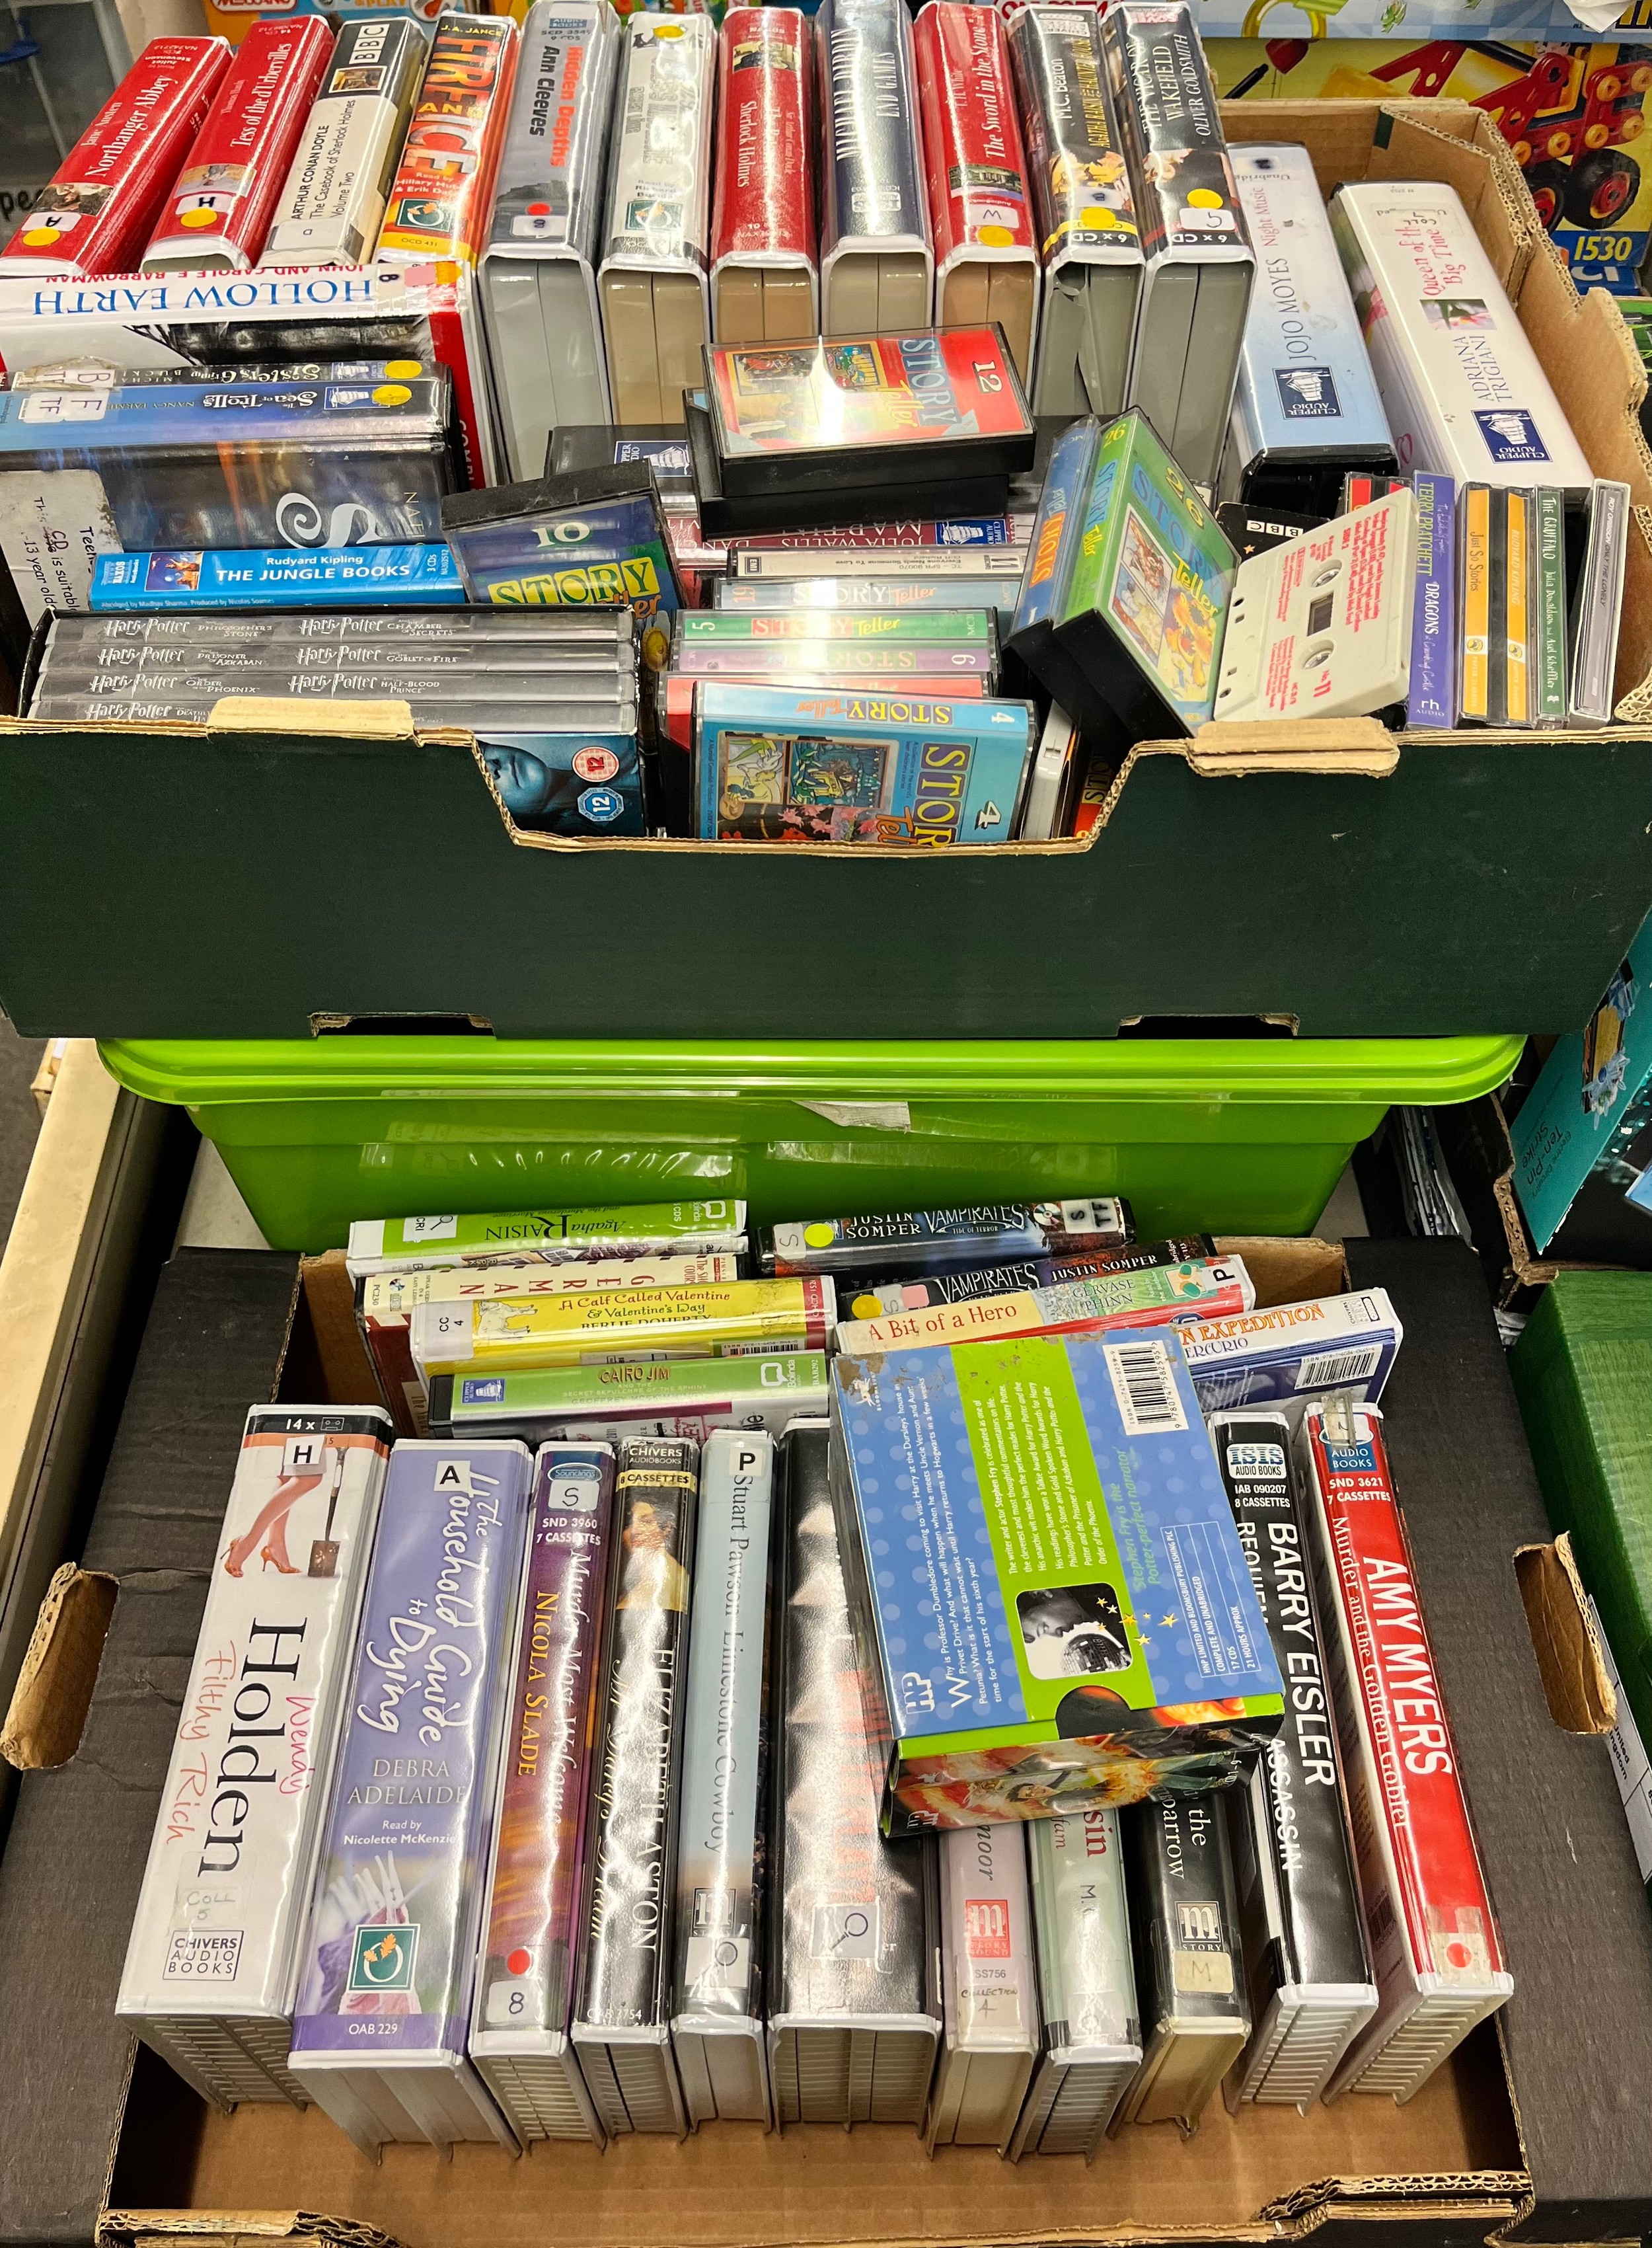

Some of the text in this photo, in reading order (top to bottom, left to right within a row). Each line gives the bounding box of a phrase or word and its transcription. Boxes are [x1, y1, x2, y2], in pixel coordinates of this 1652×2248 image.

[441, 24, 502, 37] J.A. JANCE
[529, 46, 561, 136] Ann Cleeves
[873, 52, 900, 118] END GAMES
[1152, 46, 1185, 121] WAKEFIELD
[1174, 34, 1211, 136] OLIVER GOLDSMITH
[338, 100, 356, 125] Holmes
[549, 46, 584, 167] Hidden Depths
[85, 75, 178, 178] Northanger Abbey
[328, 126, 348, 156] Sherlock
[737, 100, 757, 188] Sherlock Holmes
[291, 125, 329, 219] ARTHUR CONAN DOYLE
[315, 165, 336, 202] Casebook
[330, 172, 354, 217] Volume Two
[310, 204, 324, 219] The
[1254, 188, 1280, 247] Night Music
[1430, 229, 1466, 286] Big Time
[1573, 235, 1633, 261] 1530
[32, 280, 373, 315] HOLLOW EARTH
[1271, 257, 1317, 361] JOJO MOYES
[972, 361, 1003, 394] 12
[1453, 334, 1513, 403] ADRIANA TRIGIANI
[876, 338, 962, 428] STORY Teller
[1493, 451, 1546, 460] CLIPPER
[1164, 467, 1205, 527] 26
[530, 522, 591, 548] 10
[1416, 482, 1434, 576] TERRY PRATCHETT
[1540, 496, 1558, 560] THE GRUFFALO
[1604, 512, 1614, 545] ORBISON
[266, 553, 363, 566] Rudyard Kipling
[1604, 545, 1612, 562] ONLY
[216, 564, 410, 583] THE JUNGLE BOOKS
[488, 557, 660, 604] STORY
[1600, 580, 1609, 607] LONELY
[97, 648, 140, 666] Harry
[139, 646, 185, 672] Potter
[295, 647, 338, 666] Harry
[337, 646, 382, 670] Potter
[1415, 709, 1445, 717] AUDIO
[593, 796, 610, 812] 12
[974, 801, 1001, 829] 4
[415, 1217, 425, 1231] CRI
[484, 1215, 627, 1241] Agatha RAISIN
[1051, 1255, 1158, 1282] JUSTIN SOMPER
[1213, 1268, 1235, 1282] P
[558, 1291, 731, 1311] A Calf Called Valentine
[1072, 1278, 1136, 1312] GERVASE PHINN
[439, 1317, 449, 1332] CC
[868, 1303, 1018, 1342] A Bit of a Hero
[1202, 1303, 1326, 1341] EXPEDITION
[598, 1365, 671, 1384] CAIRO JIM
[786, 1359, 796, 1388] Bolinda
[285, 1418, 315, 1431] 14 x
[293, 1444, 313, 1465] H
[629, 1447, 683, 1457] CHIVERS
[739, 1452, 757, 1471] P
[1332, 1448, 1372, 1468] AUDIO BOOKS
[439, 1465, 460, 1485] A
[554, 1467, 596, 1479] Soundings
[1235, 1465, 1281, 1476] AUDIO BOOKS
[1328, 1477, 1383, 1489] SND 3621
[1234, 1484, 1287, 1494] IAB 090207
[1326, 1491, 1391, 1504] 7 CASSETTES
[541, 1518, 597, 1530] SND 3960
[704, 1475, 754, 1853] Stuart Pawson Limestone Cowboy
[1267, 1522, 1336, 1785] BARRY EISLER
[1362, 1557, 1454, 1776] AMY MYERS
[517, 1591, 559, 1777] NICOLA SLADE
[165, 1640, 237, 1845] Filthy Rich
[198, 1617, 308, 1878] Holden
[347, 1758, 467, 1805] DEBRA ADELAIDE
[1267, 1738, 1303, 1870] ASSASSIN
[344, 1834, 457, 1845] Nicolette McKenzie
[382, 1819, 422, 1832] Read by
[1188, 1808, 1212, 1847] the
[630, 1840, 663, 1953] ASTON
[168, 1937, 238, 1974] CHIVERS AUDIO BOOKS
[974, 1969, 1006, 1978] SS756
[509, 1992, 525, 2015] 8
[349, 2023, 398, 2035] OAB 229
